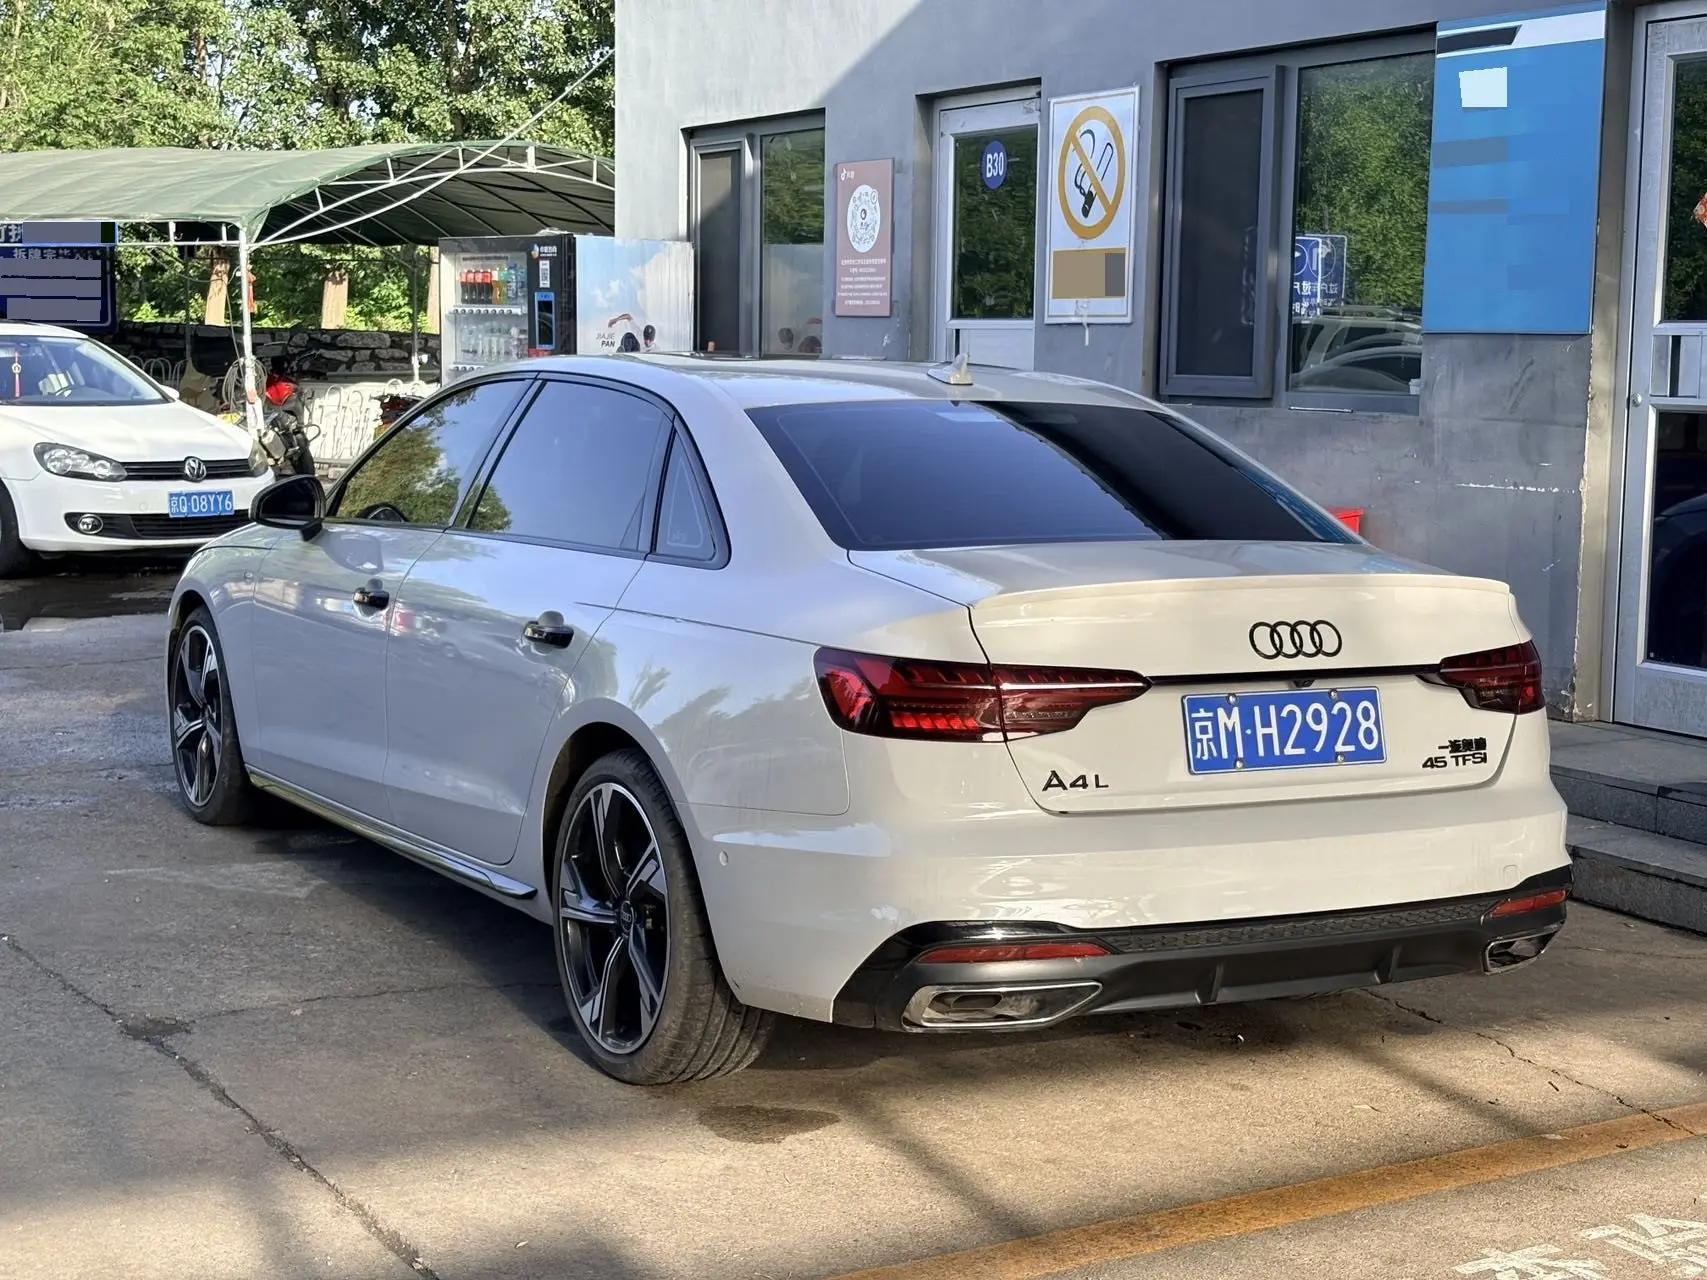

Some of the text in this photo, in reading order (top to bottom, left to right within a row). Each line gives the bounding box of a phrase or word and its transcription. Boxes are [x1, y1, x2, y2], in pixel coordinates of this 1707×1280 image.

[986, 151, 1004, 179] B30
[1422, 752, 1487, 768] 45 TFSI
